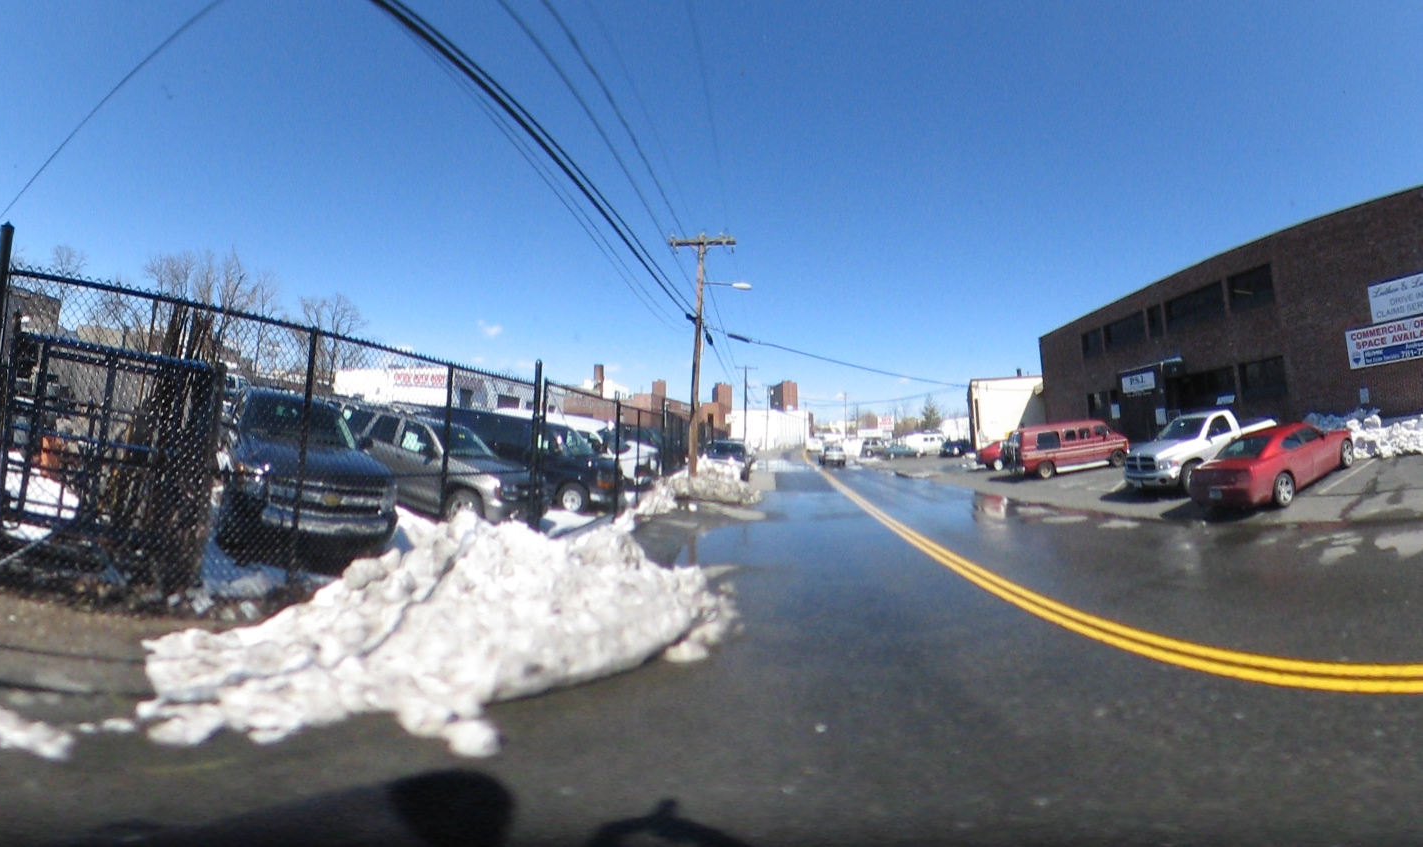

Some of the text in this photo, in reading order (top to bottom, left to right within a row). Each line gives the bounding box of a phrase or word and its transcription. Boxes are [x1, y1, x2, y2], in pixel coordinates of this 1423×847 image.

[1390, 294, 1413, 305] DRIVE
[1377, 306, 1405, 318] CLAIMS
[1351, 323, 1407, 340] COMMERCIAL
[1356, 338, 1386, 349] SPACE
